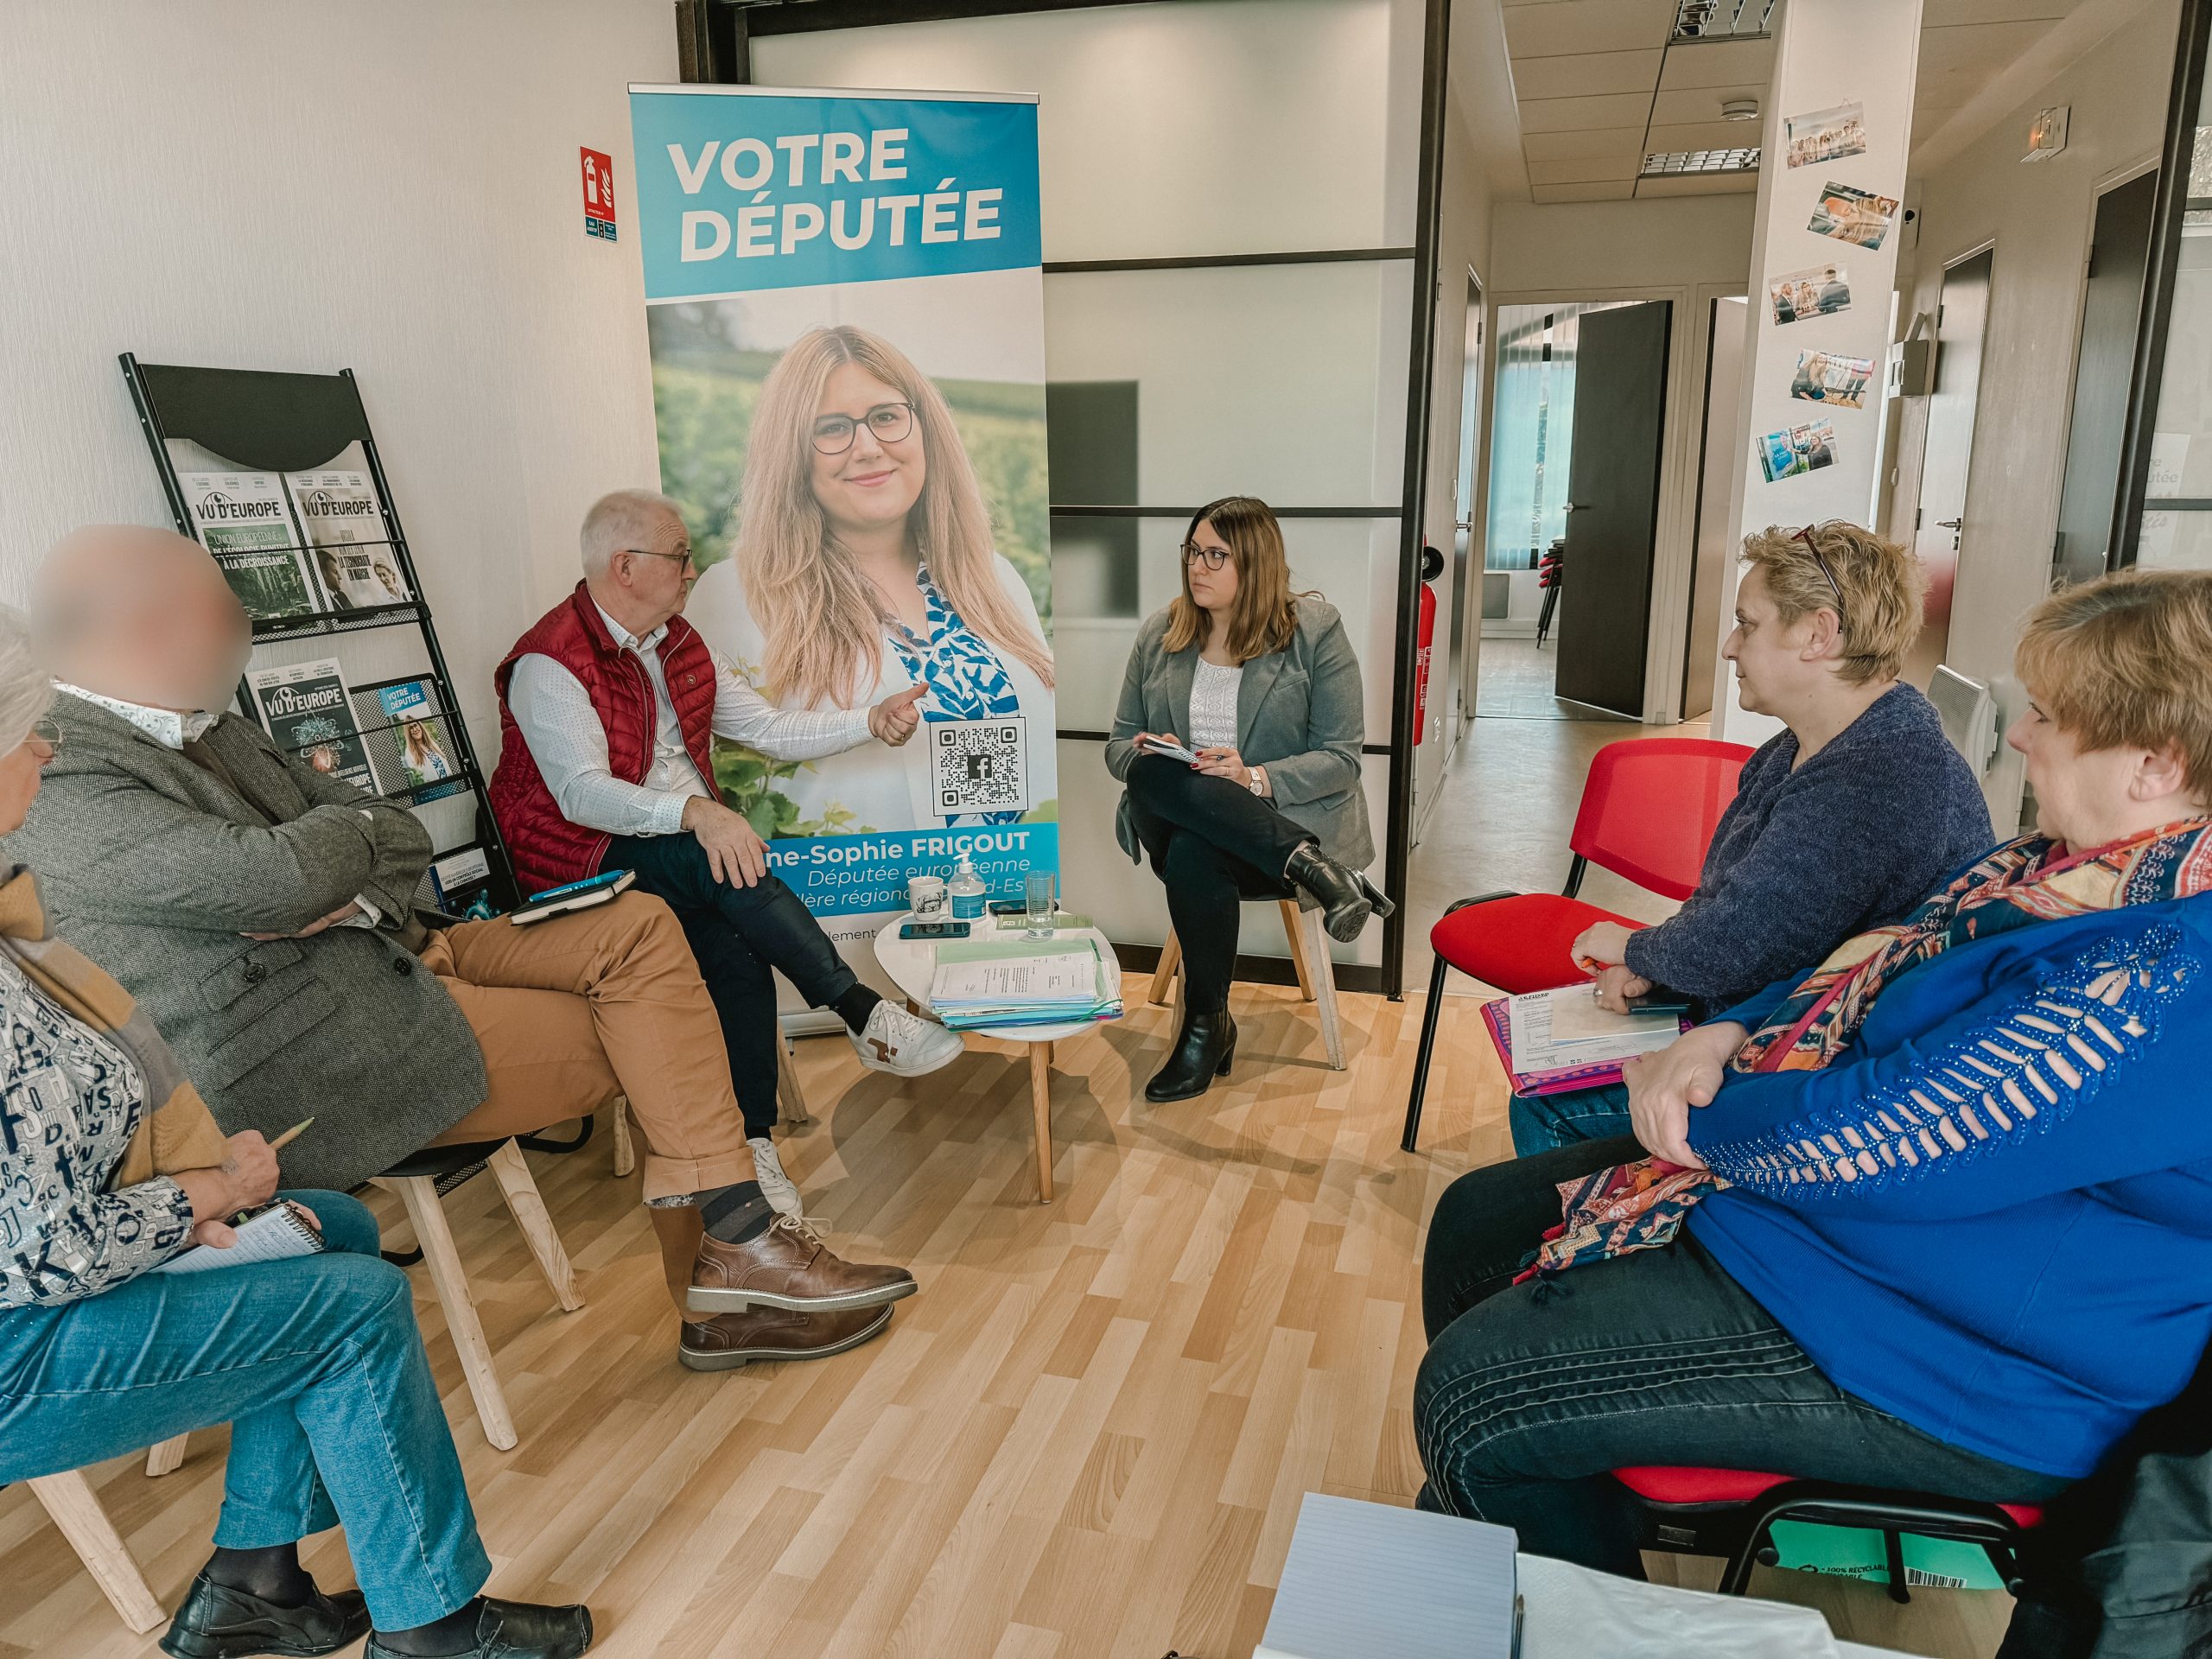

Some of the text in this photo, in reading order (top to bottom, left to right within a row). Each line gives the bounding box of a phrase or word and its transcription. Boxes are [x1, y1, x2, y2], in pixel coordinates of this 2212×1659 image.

[666, 128, 909, 194] VOTRE
[680, 177, 1003, 262] DÉPUTÉE
[2148, 470, 2177, 483] utée
[195, 502, 281, 519] VU D'EUROPE
[321, 501, 374, 516] D'EUROPE
[239, 556, 289, 569] DÉCROISSANCE
[265, 699, 284, 716] VU
[285, 689, 342, 713] D'EUROPE
[387, 687, 409, 701] VOTRE
[766, 831, 1030, 868] ne-Sophie FRIGOUT
[808, 865, 899, 888] Députée
[842, 887, 910, 906] région
[829, 928, 877, 942] lement
